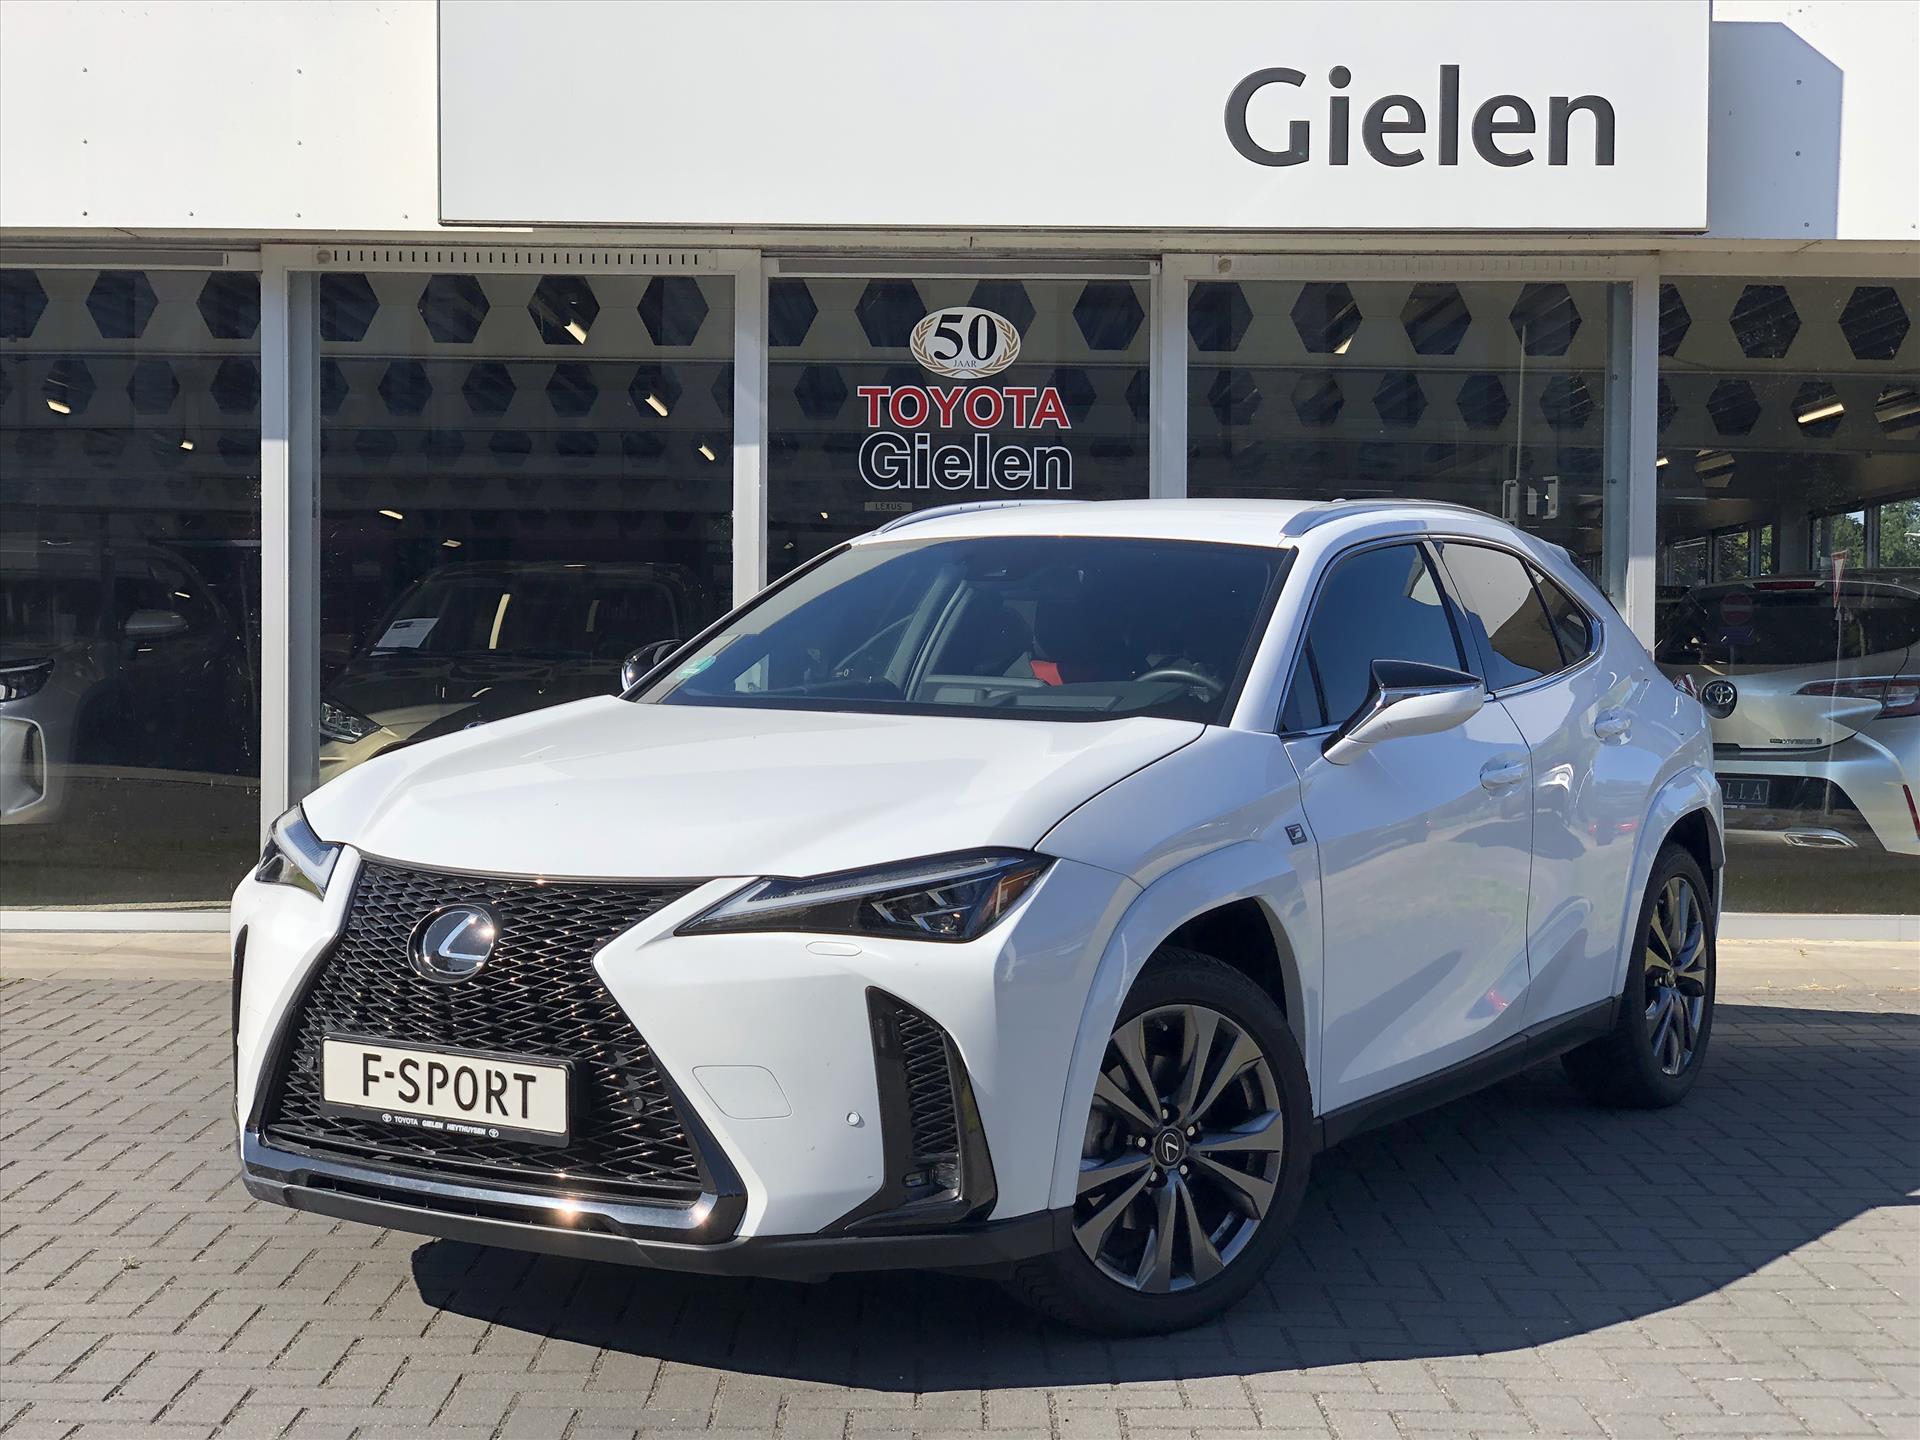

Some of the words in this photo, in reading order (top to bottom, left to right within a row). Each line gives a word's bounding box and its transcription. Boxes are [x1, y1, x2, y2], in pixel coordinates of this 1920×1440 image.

[1224, 64, 1615, 168] Gielen
[934, 314, 997, 360] 50
[953, 359, 977, 368] JAAR
[857, 385, 1072, 429] TOYOTA
[858, 431, 1072, 490] Gielen
[875, 503, 903, 511] LEXUS
[363, 1053, 536, 1118] F-SPORT
[394, 1116, 418, 1126] TOYOTA
[422, 1120, 444, 1130] GIELEN
[446, 1124, 486, 1135] HEYTHUYSEN
